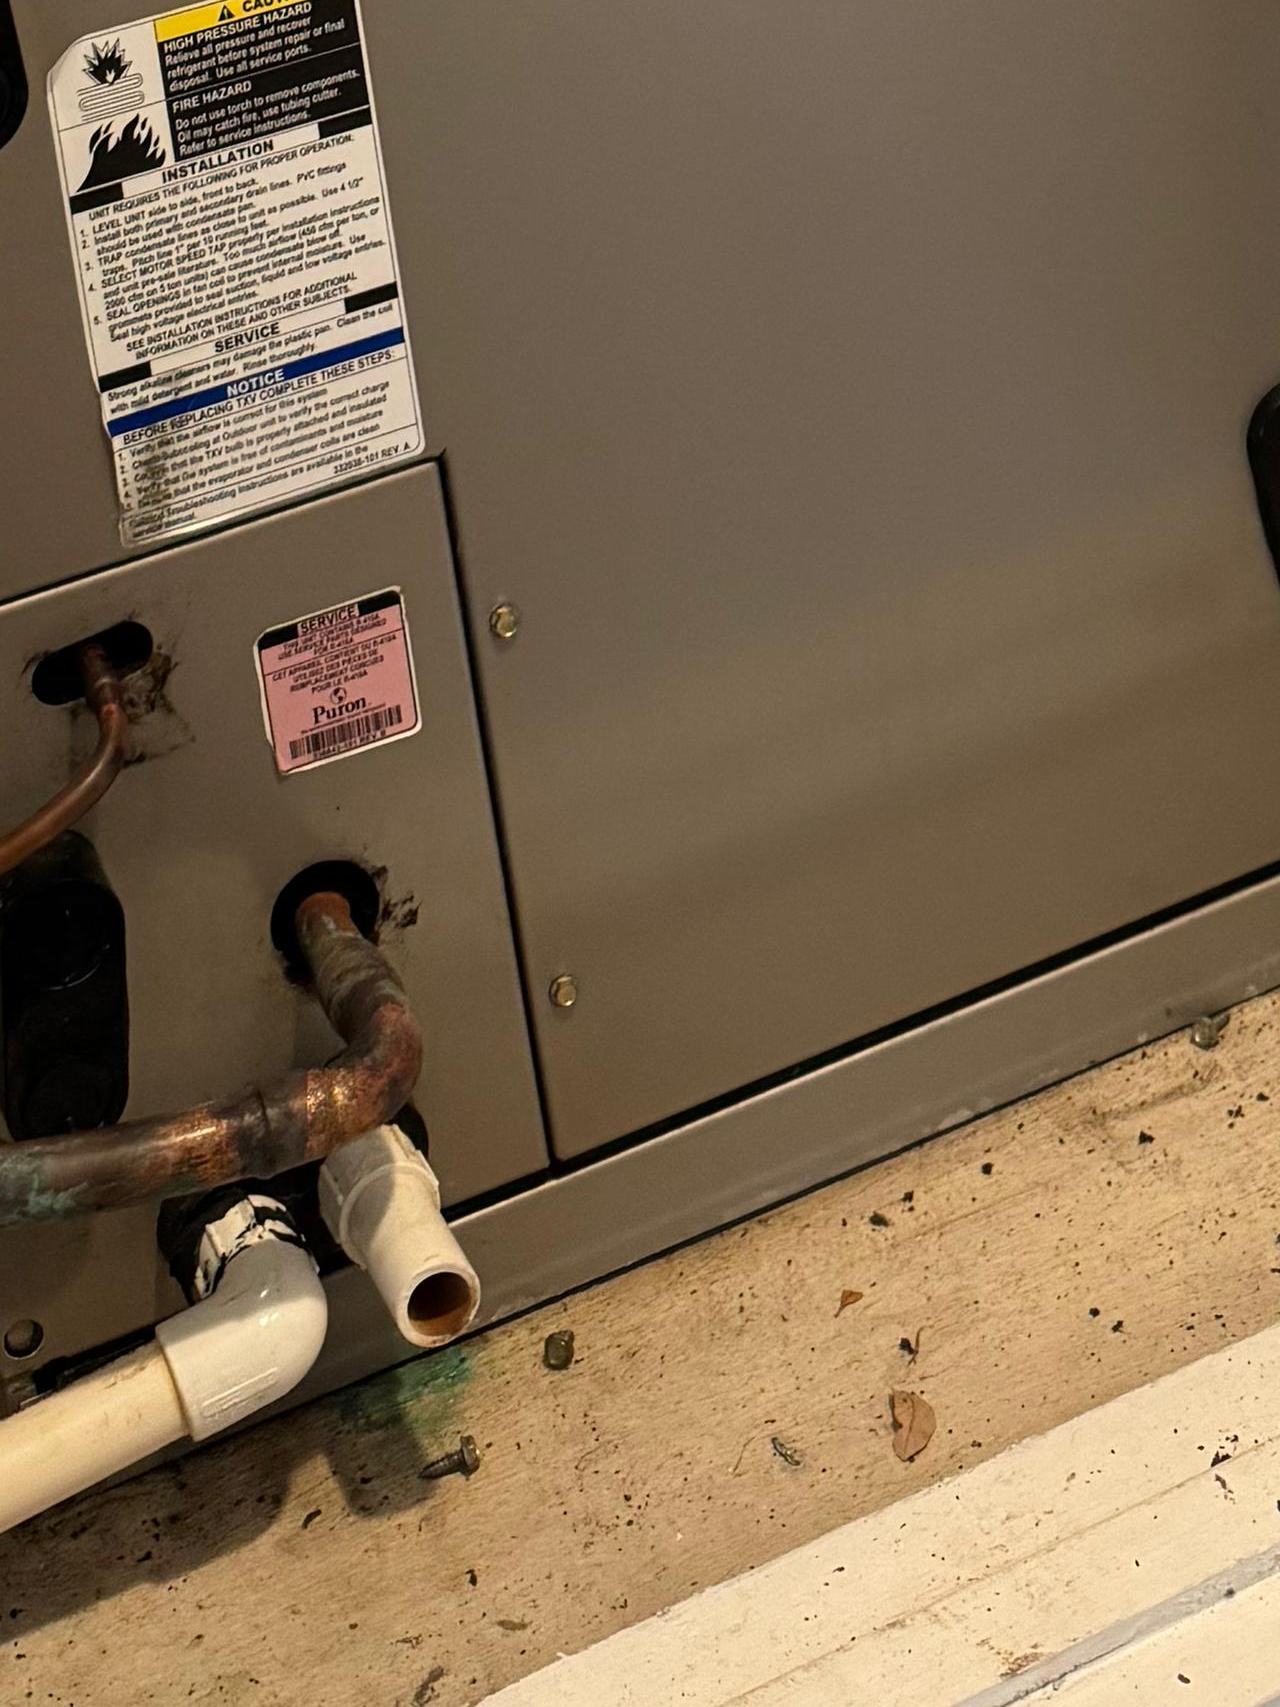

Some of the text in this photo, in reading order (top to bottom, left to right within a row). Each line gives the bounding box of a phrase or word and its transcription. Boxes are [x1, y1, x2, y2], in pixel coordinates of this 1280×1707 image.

[163, 1, 312, 54] HIGH PRESSURE HAZARD
[164, 16, 311, 67] Relieve all pressure and recover
[167, 18, 345, 80] refrigerant before system repair or final
[169, 44, 309, 93] disposal. Use all service ports.
[172, 80, 252, 113] FIRE HAZARD
[175, 69, 361, 131] Do not use torch to remove components.
[177, 129, 191, 143] Oil
[192, 125, 213, 139] may
[214, 116, 241, 132] catch
[262, 105, 280, 119] use
[280, 96, 311, 113] tubing
[311, 87, 341, 103] cutter.
[179, 110, 311, 157] Refer to service instructions.
[88, 206, 111, 222] UNIT
[112, 191, 161, 214] REQUIRES
[161, 185, 181, 199] THE
[182, 167, 238, 193] FOLLOWING
[239, 161, 259, 176] FOR
[260, 149, 298, 169] PROPER
[161, 138, 274, 184] INSTALLATION
[92, 218, 123, 235] LEVEL
[124, 210, 146, 225] UNIT
[148, 206, 167, 218] side
[168, 202, 178, 212] to
[201, 187, 224, 201] front
[224, 185, 234, 194] to
[126, 271, 358, 352] SEE INSTALLATION INSTRUCTIONS FOR ADDITIONAL
[135, 332, 199, 360] INFORMATION
[200, 328, 215, 340] ON
[216, 316, 247, 334] THESE
[248, 310, 269, 325] AND
[269, 300, 301, 318] OTHER
[214, 321, 281, 353] SERVICE
[123, 421, 169, 446] BEFORE
[169, 400, 234, 431] REPLACING
[235, 392, 257, 409] TXV
[258, 372, 319, 401] COMPLETE
[320, 360, 355, 381] THESE
[226, 368, 285, 398] NOTICE
[300, 604, 356, 635] SERVICE
[312, 697, 367, 725] Puron
